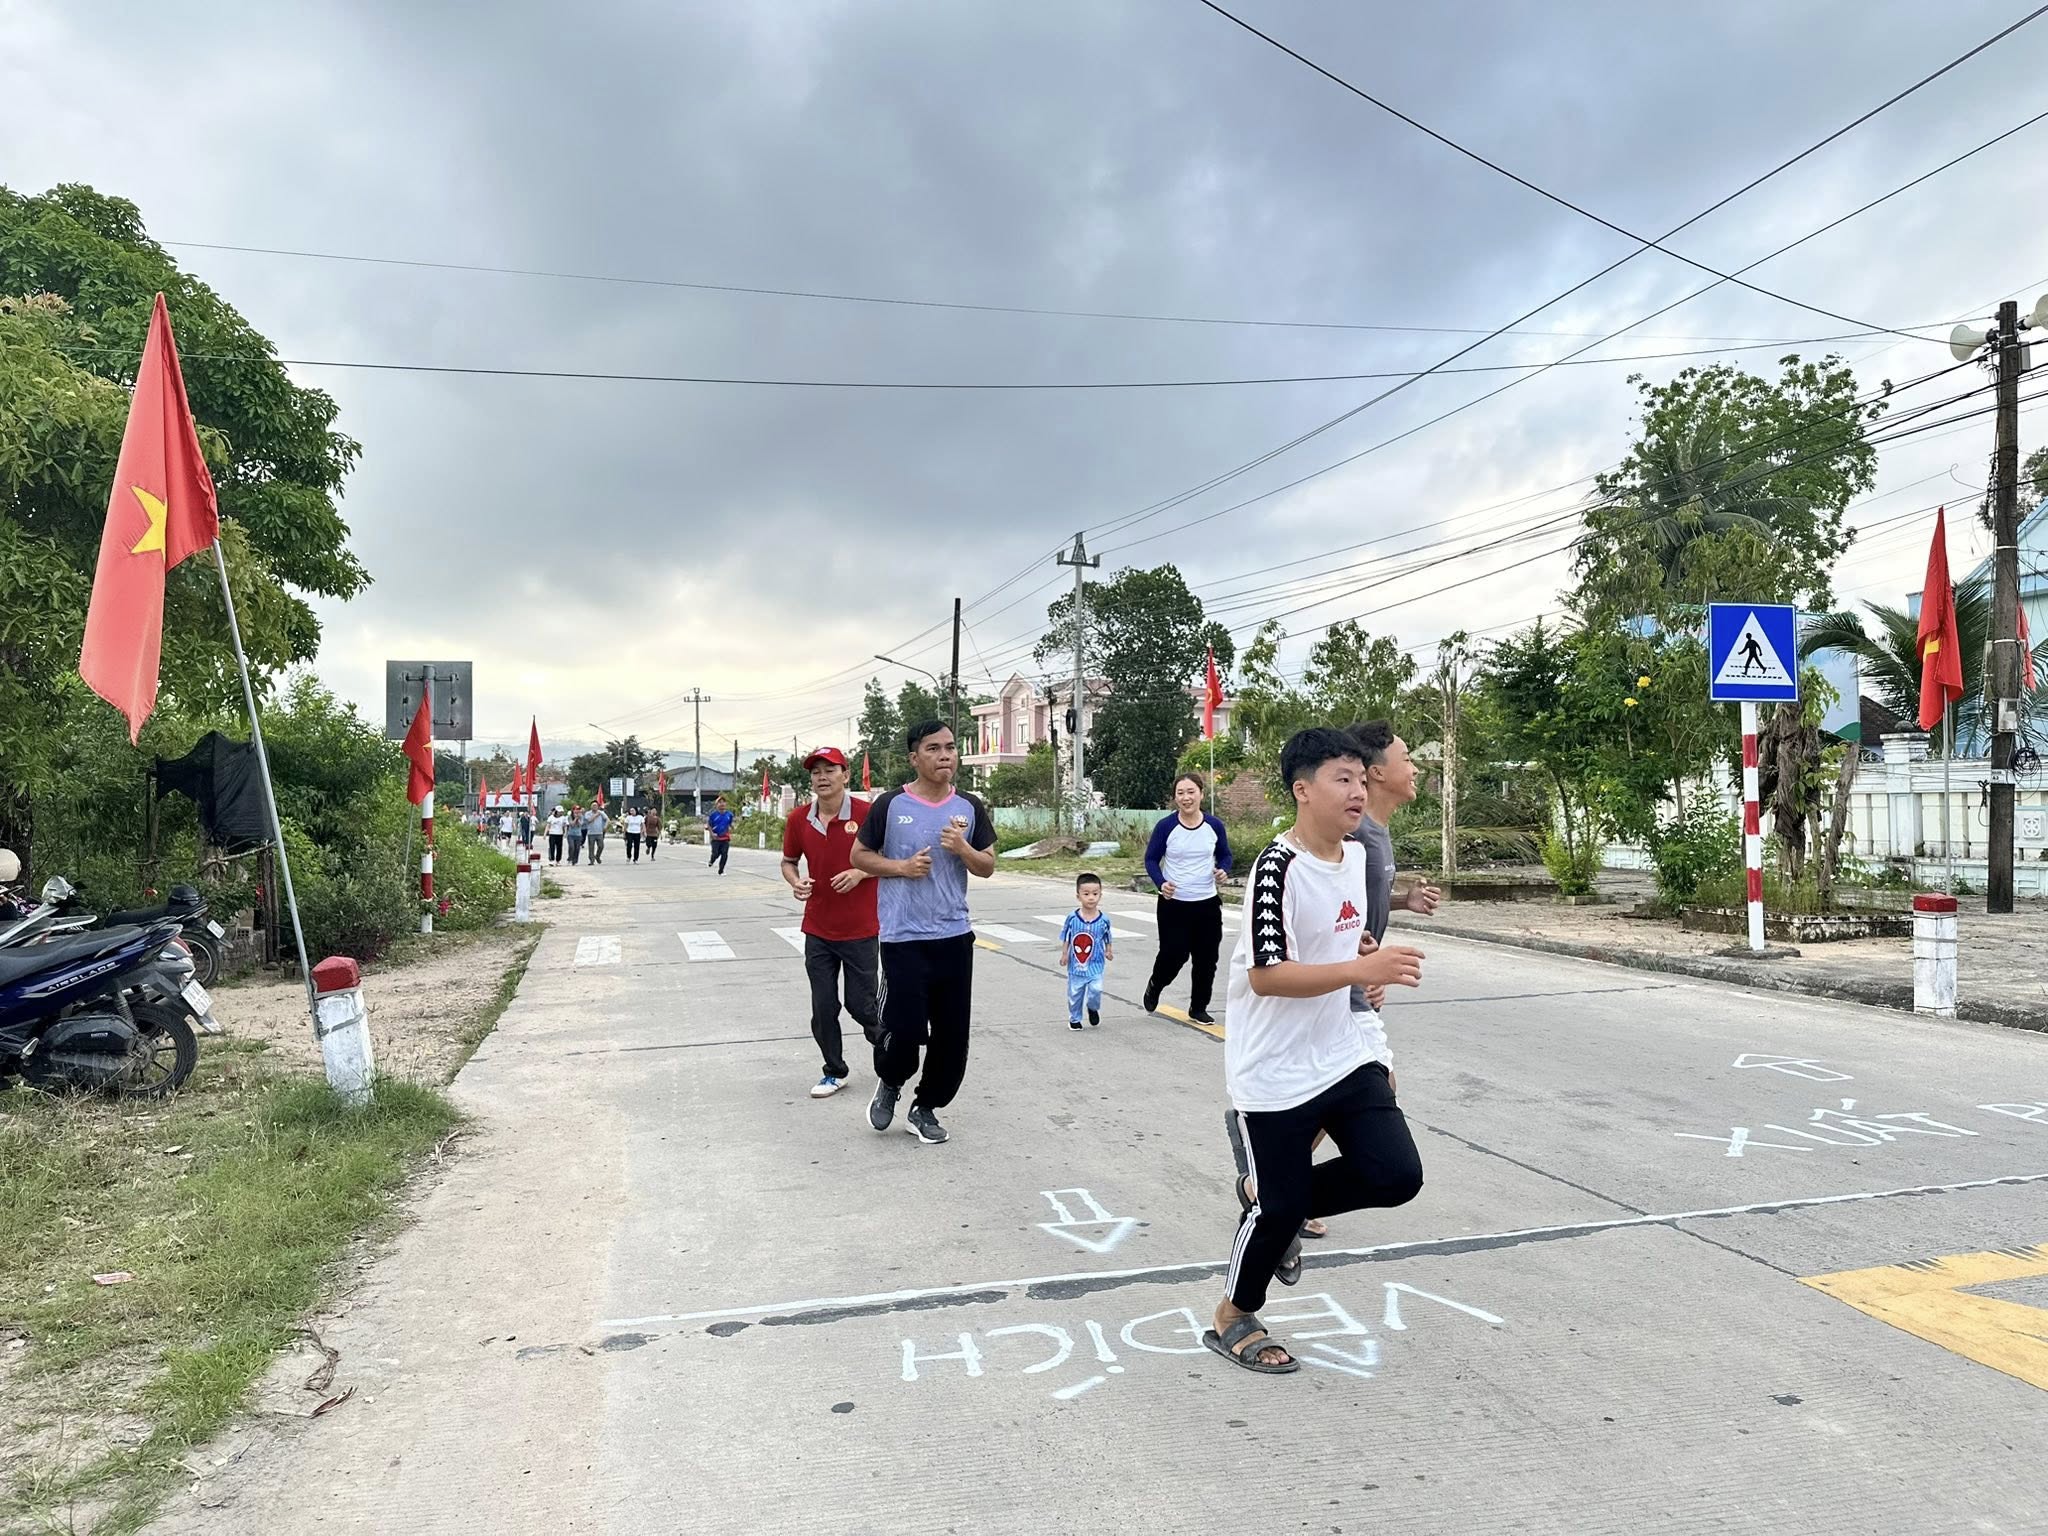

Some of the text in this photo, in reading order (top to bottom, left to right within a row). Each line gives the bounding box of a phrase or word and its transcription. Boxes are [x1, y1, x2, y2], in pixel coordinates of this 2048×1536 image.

[1334, 919, 1361, 933] MEXICO
[1674, 1098, 2048, 1157] XUẤT P
